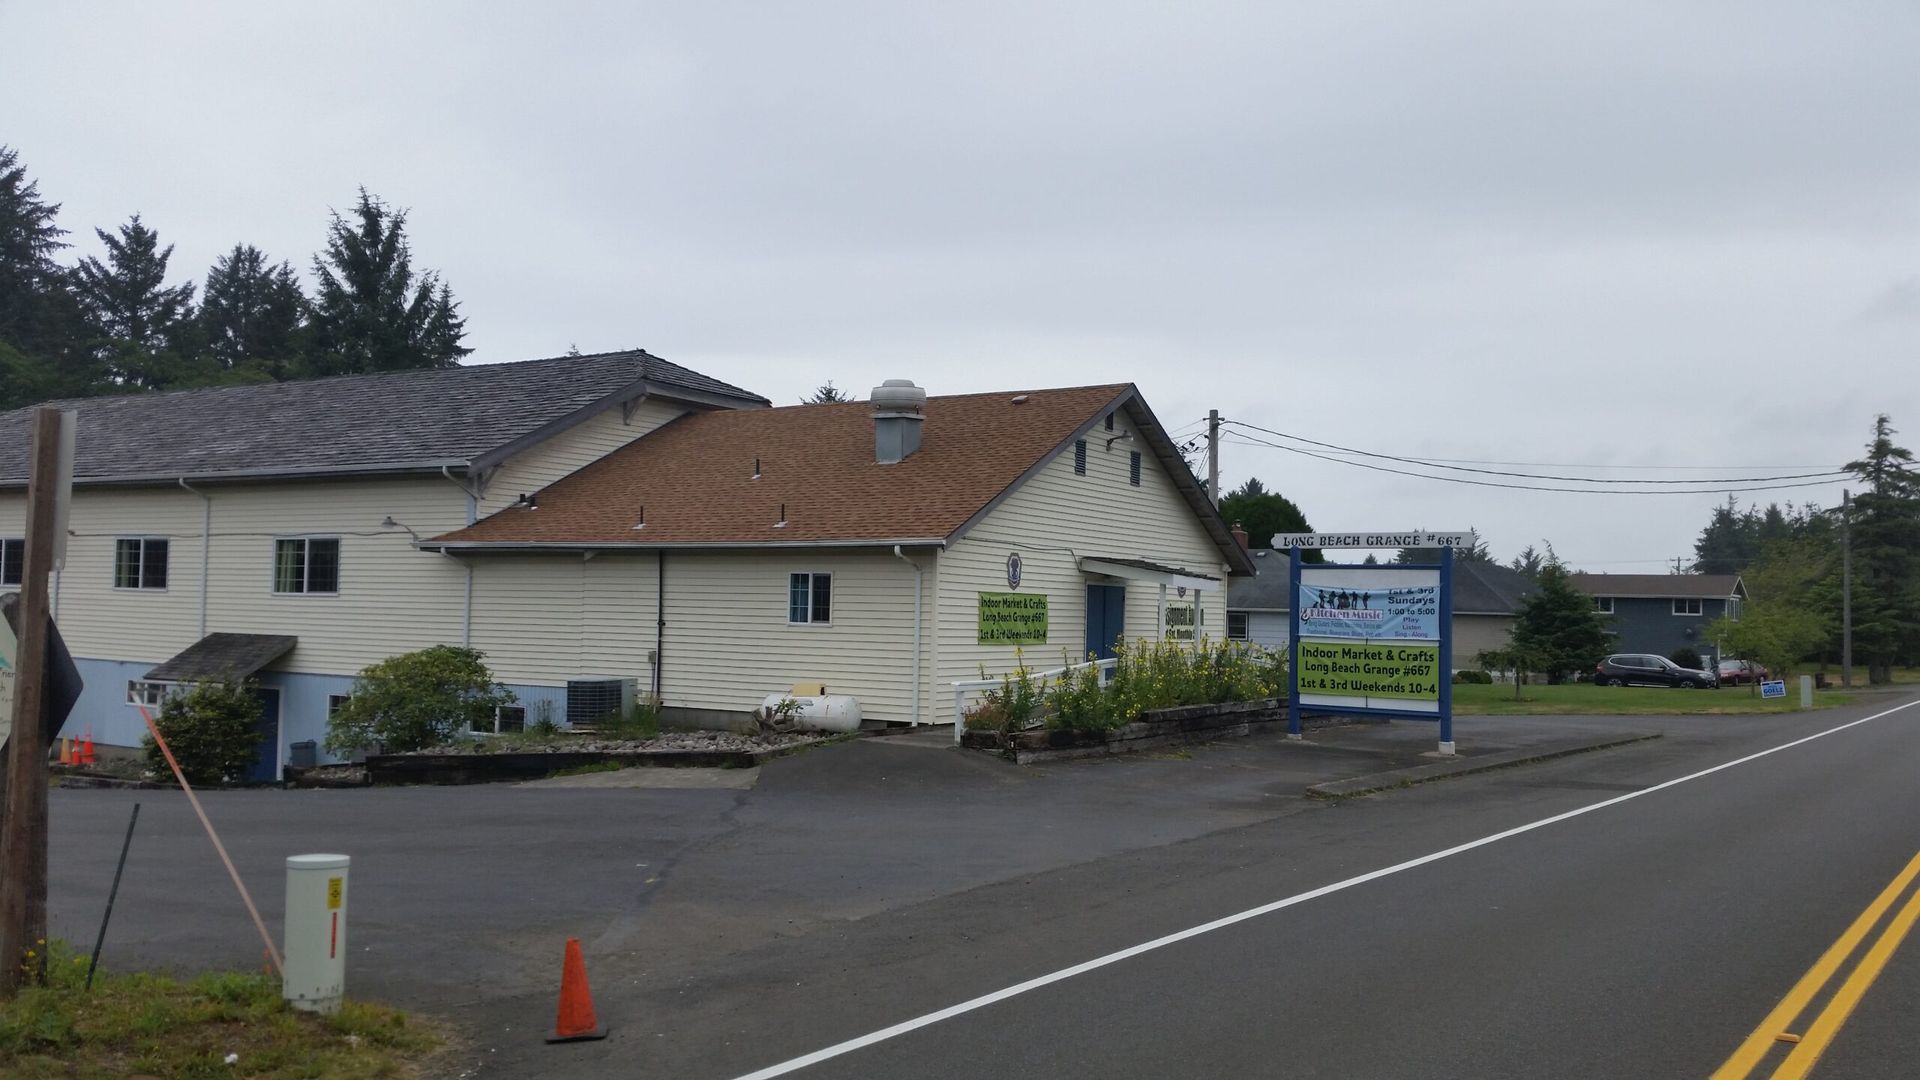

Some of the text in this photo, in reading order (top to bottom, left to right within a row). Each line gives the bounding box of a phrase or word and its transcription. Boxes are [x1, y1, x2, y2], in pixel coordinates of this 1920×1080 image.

[1283, 534, 1462, 547] LONG BEACH GRANGE #667
[981, 596, 1046, 610] Indoor Market & Crafts
[1388, 596, 1435, 606] Sundays
[982, 610, 997, 625] Long
[1352, 610, 1381, 619] Music
[1388, 608, 1405, 616] 1:00
[1417, 608, 1436, 616] 5:00
[980, 629, 989, 639] 1st
[996, 629, 1006, 639] 3rd
[1006, 629, 1033, 639] Weekends
[1033, 629, 1046, 639] 10-4
[1302, 646, 1435, 663] Indoor Market & Crafts
[1305, 661, 1431, 678] Long Beach Grange #667
[1300, 677, 1436, 695] 1st & 3rd Weekends 10-4
